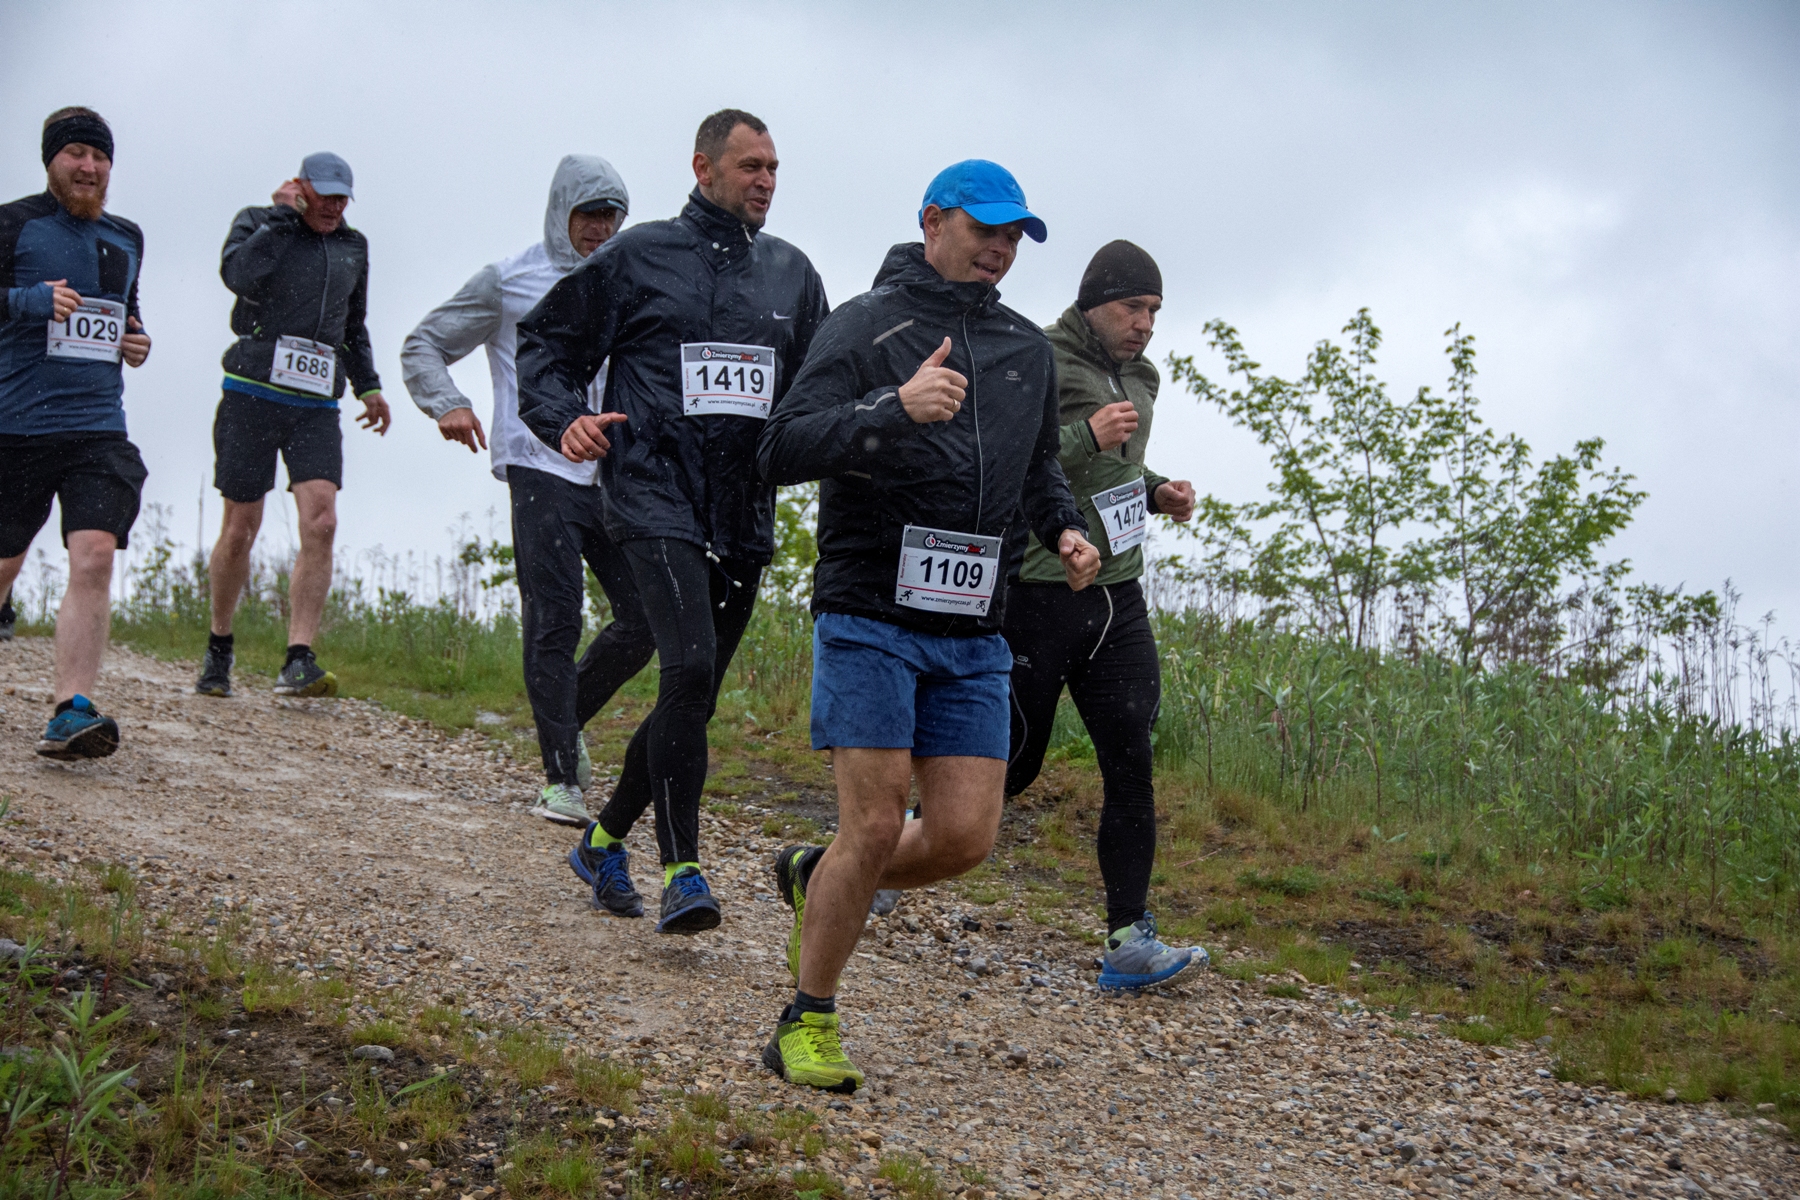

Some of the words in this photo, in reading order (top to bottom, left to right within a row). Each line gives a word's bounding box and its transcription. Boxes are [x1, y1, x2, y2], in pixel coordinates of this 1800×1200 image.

[65, 317, 118, 342] 1029
[284, 352, 329, 378] 1688
[696, 365, 765, 394] 1419
[1113, 500, 1145, 530] 1472
[920, 556, 983, 589] 1109
